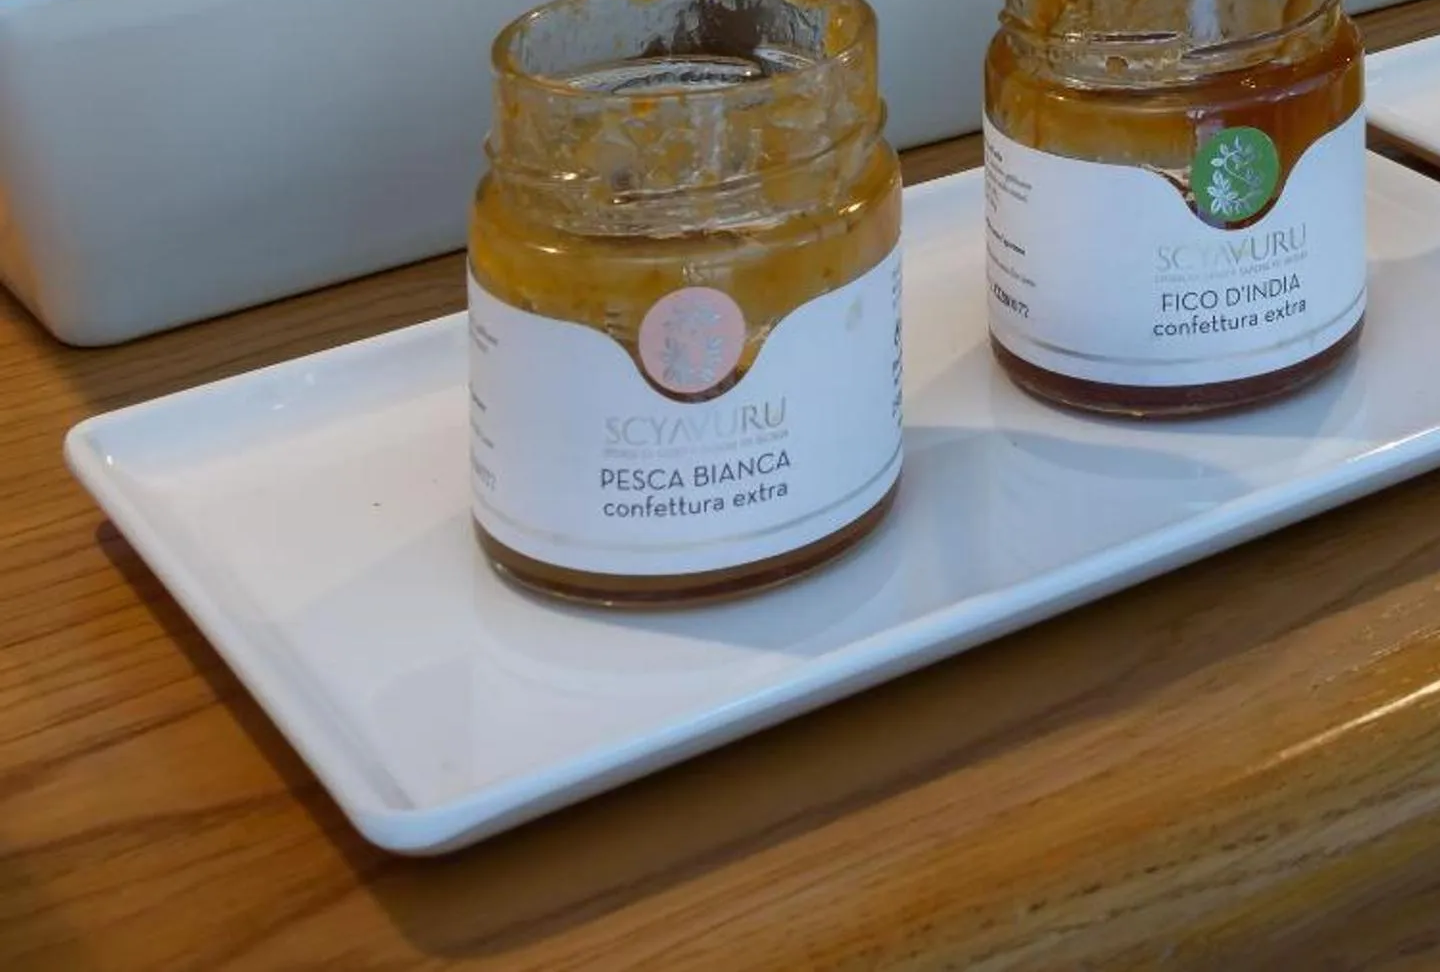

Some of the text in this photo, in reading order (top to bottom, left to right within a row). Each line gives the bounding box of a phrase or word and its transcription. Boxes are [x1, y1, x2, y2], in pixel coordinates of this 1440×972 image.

[1161, 272, 1301, 313] FICO D'INDIA
[1152, 299, 1307, 336] confettura extra
[603, 394, 787, 446] SCYAVURU
[600, 448, 792, 492] PESCA BIANCA
[602, 481, 789, 518] confettura extra
